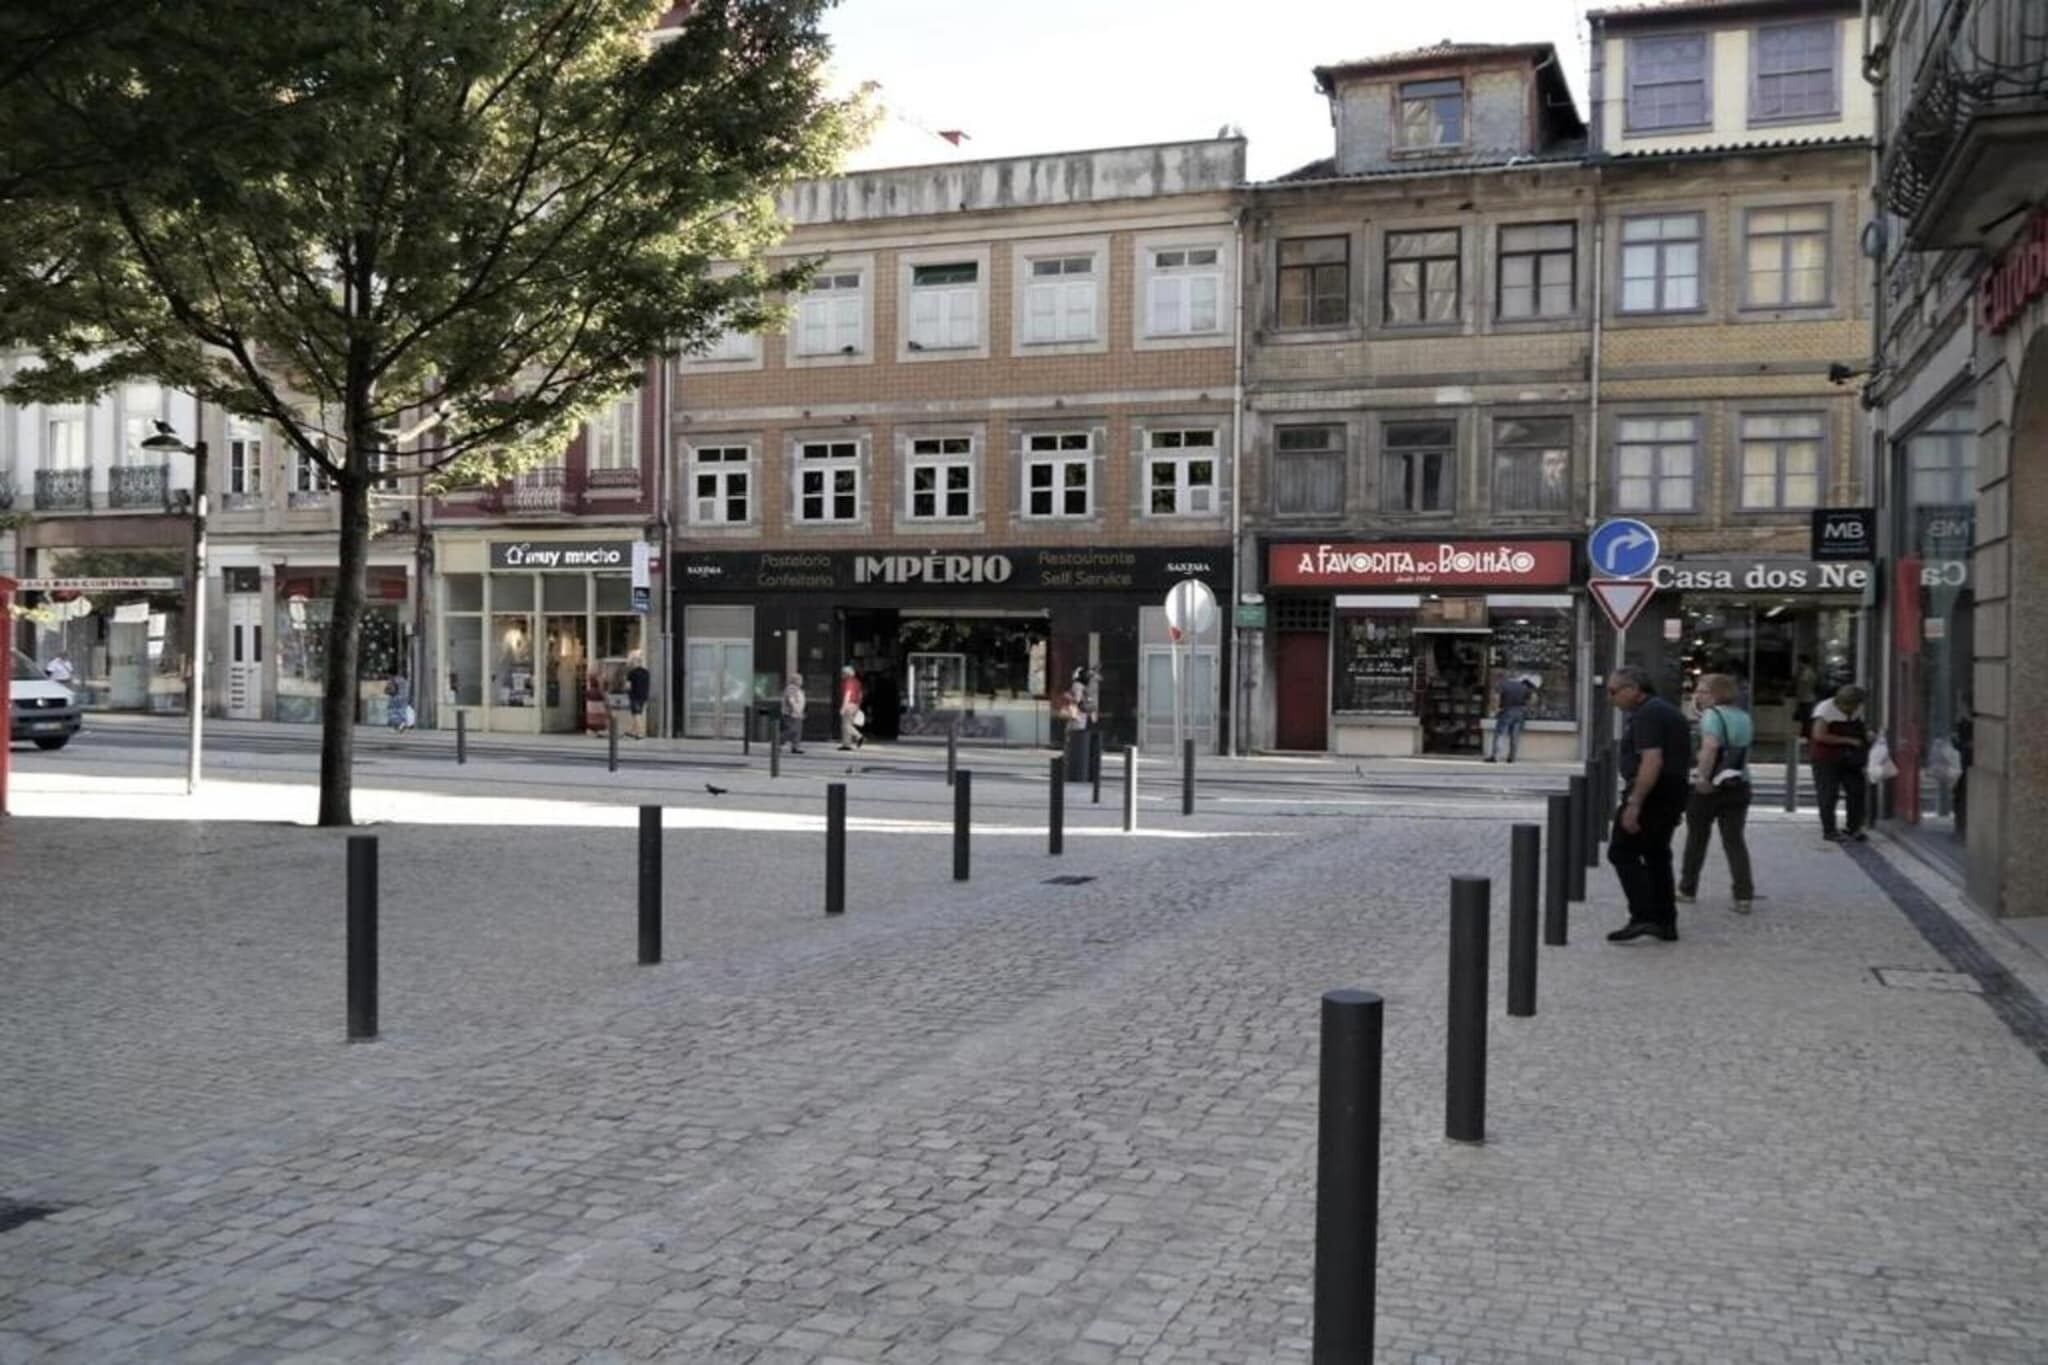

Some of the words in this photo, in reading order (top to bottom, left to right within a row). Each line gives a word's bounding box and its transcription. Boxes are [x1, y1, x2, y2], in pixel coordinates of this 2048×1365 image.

[1824, 521, 1865, 538] MB
[525, 551, 559, 567] muy
[565, 547, 620, 564] mucho
[760, 554, 831, 567] Pastelaria
[1039, 551, 1136, 565] Restaurante
[1298, 552, 1314, 573] A
[1317, 545, 1415, 574] FAVORITA
[1417, 561, 1437, 573] DO
[1438, 544, 1535, 573] BOLHÃO
[854, 549, 1013, 584] IMPÉRIO
[758, 573, 834, 586] Confeitaria
[1041, 570, 1071, 586] Self
[1075, 570, 1133, 586] Service
[1651, 565, 1734, 589] Casa
[1744, 564, 1808, 589] dos
[1816, 563, 1867, 588] Ne
